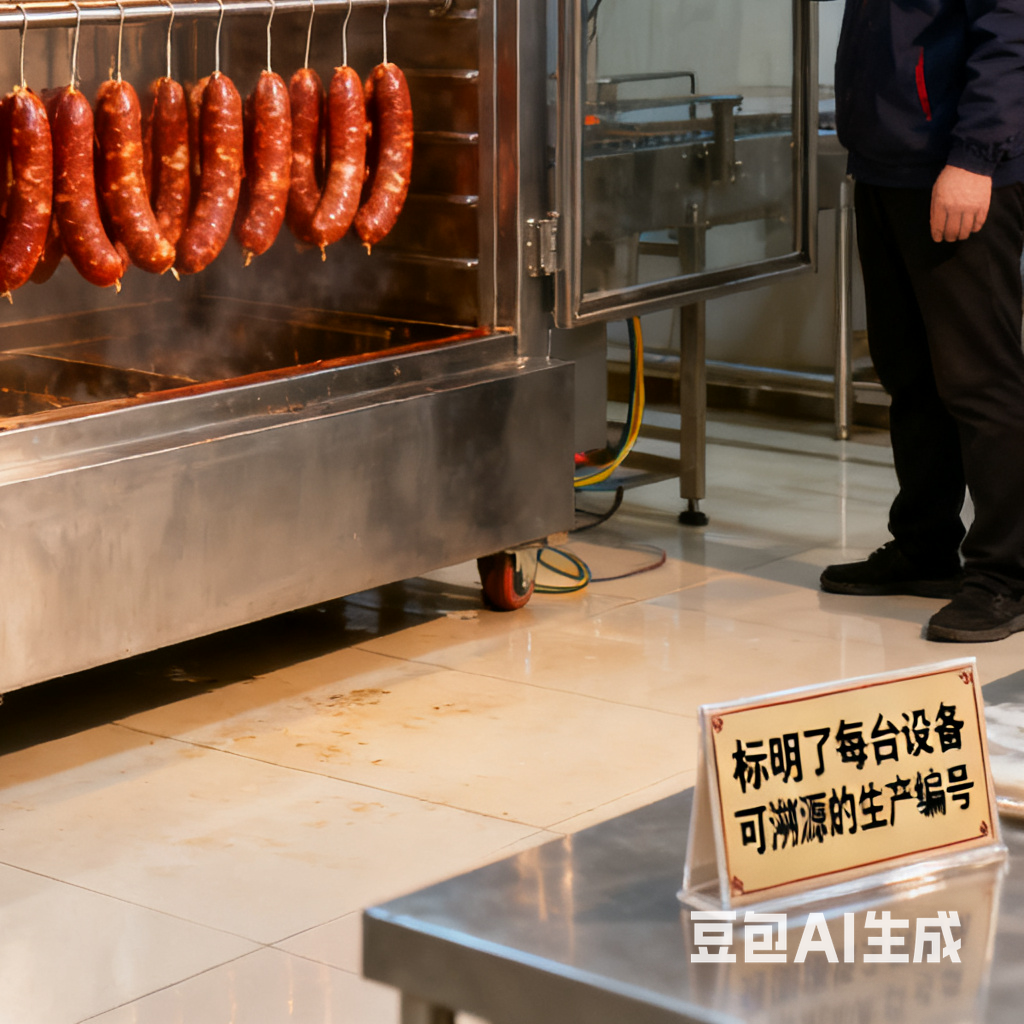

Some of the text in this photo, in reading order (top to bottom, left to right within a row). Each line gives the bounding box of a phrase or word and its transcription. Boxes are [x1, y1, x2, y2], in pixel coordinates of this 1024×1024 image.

[732, 701, 965, 793] 标明了每台设备
